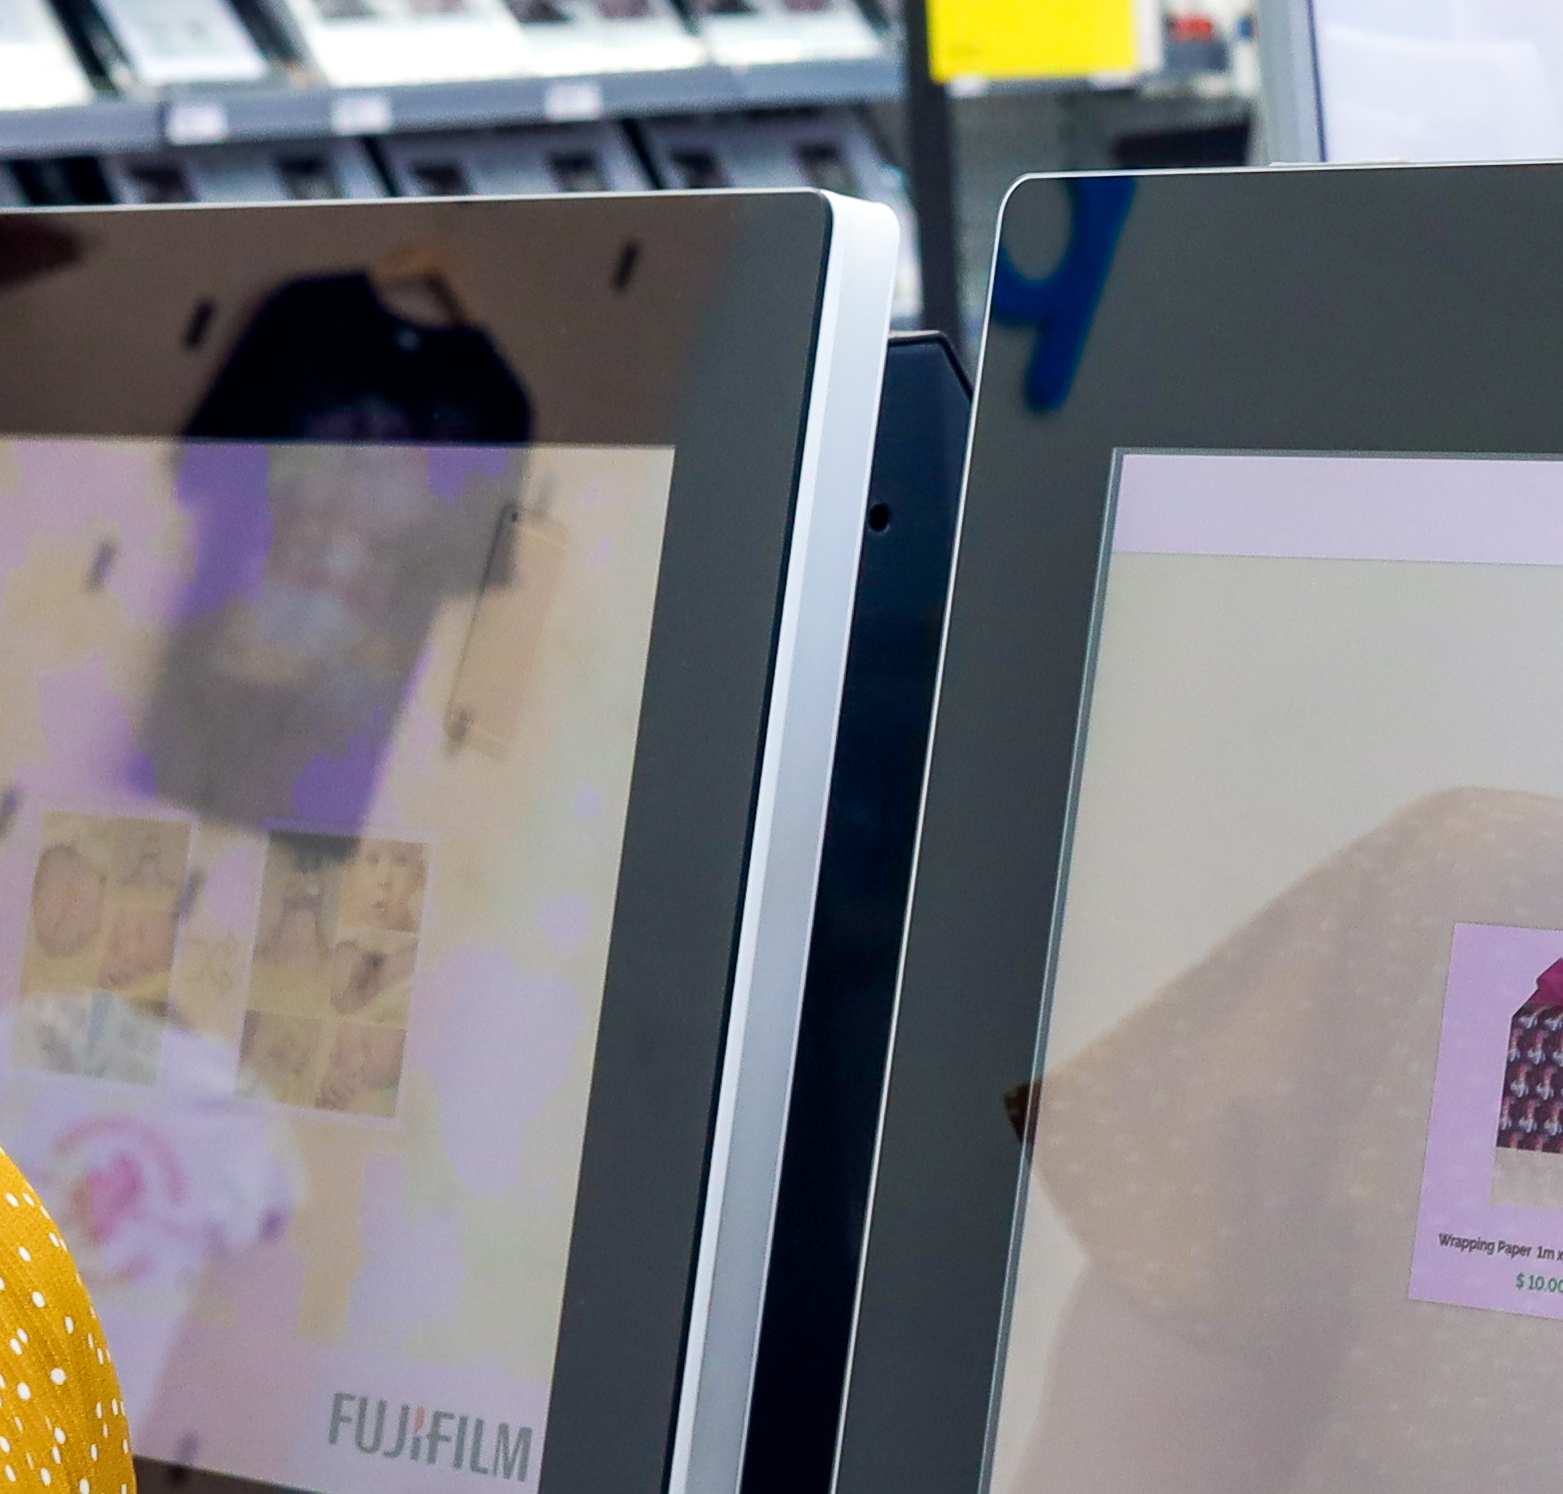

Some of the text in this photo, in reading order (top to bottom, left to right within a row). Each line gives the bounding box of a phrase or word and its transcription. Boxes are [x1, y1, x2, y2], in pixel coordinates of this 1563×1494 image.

[1439, 1232, 1495, 1254] Wrapping
[1497, 1241, 1531, 1258] Paper
[1538, 1245, 1555, 1260] 1m
[329, 1392, 533, 1483] FUJIFILM
